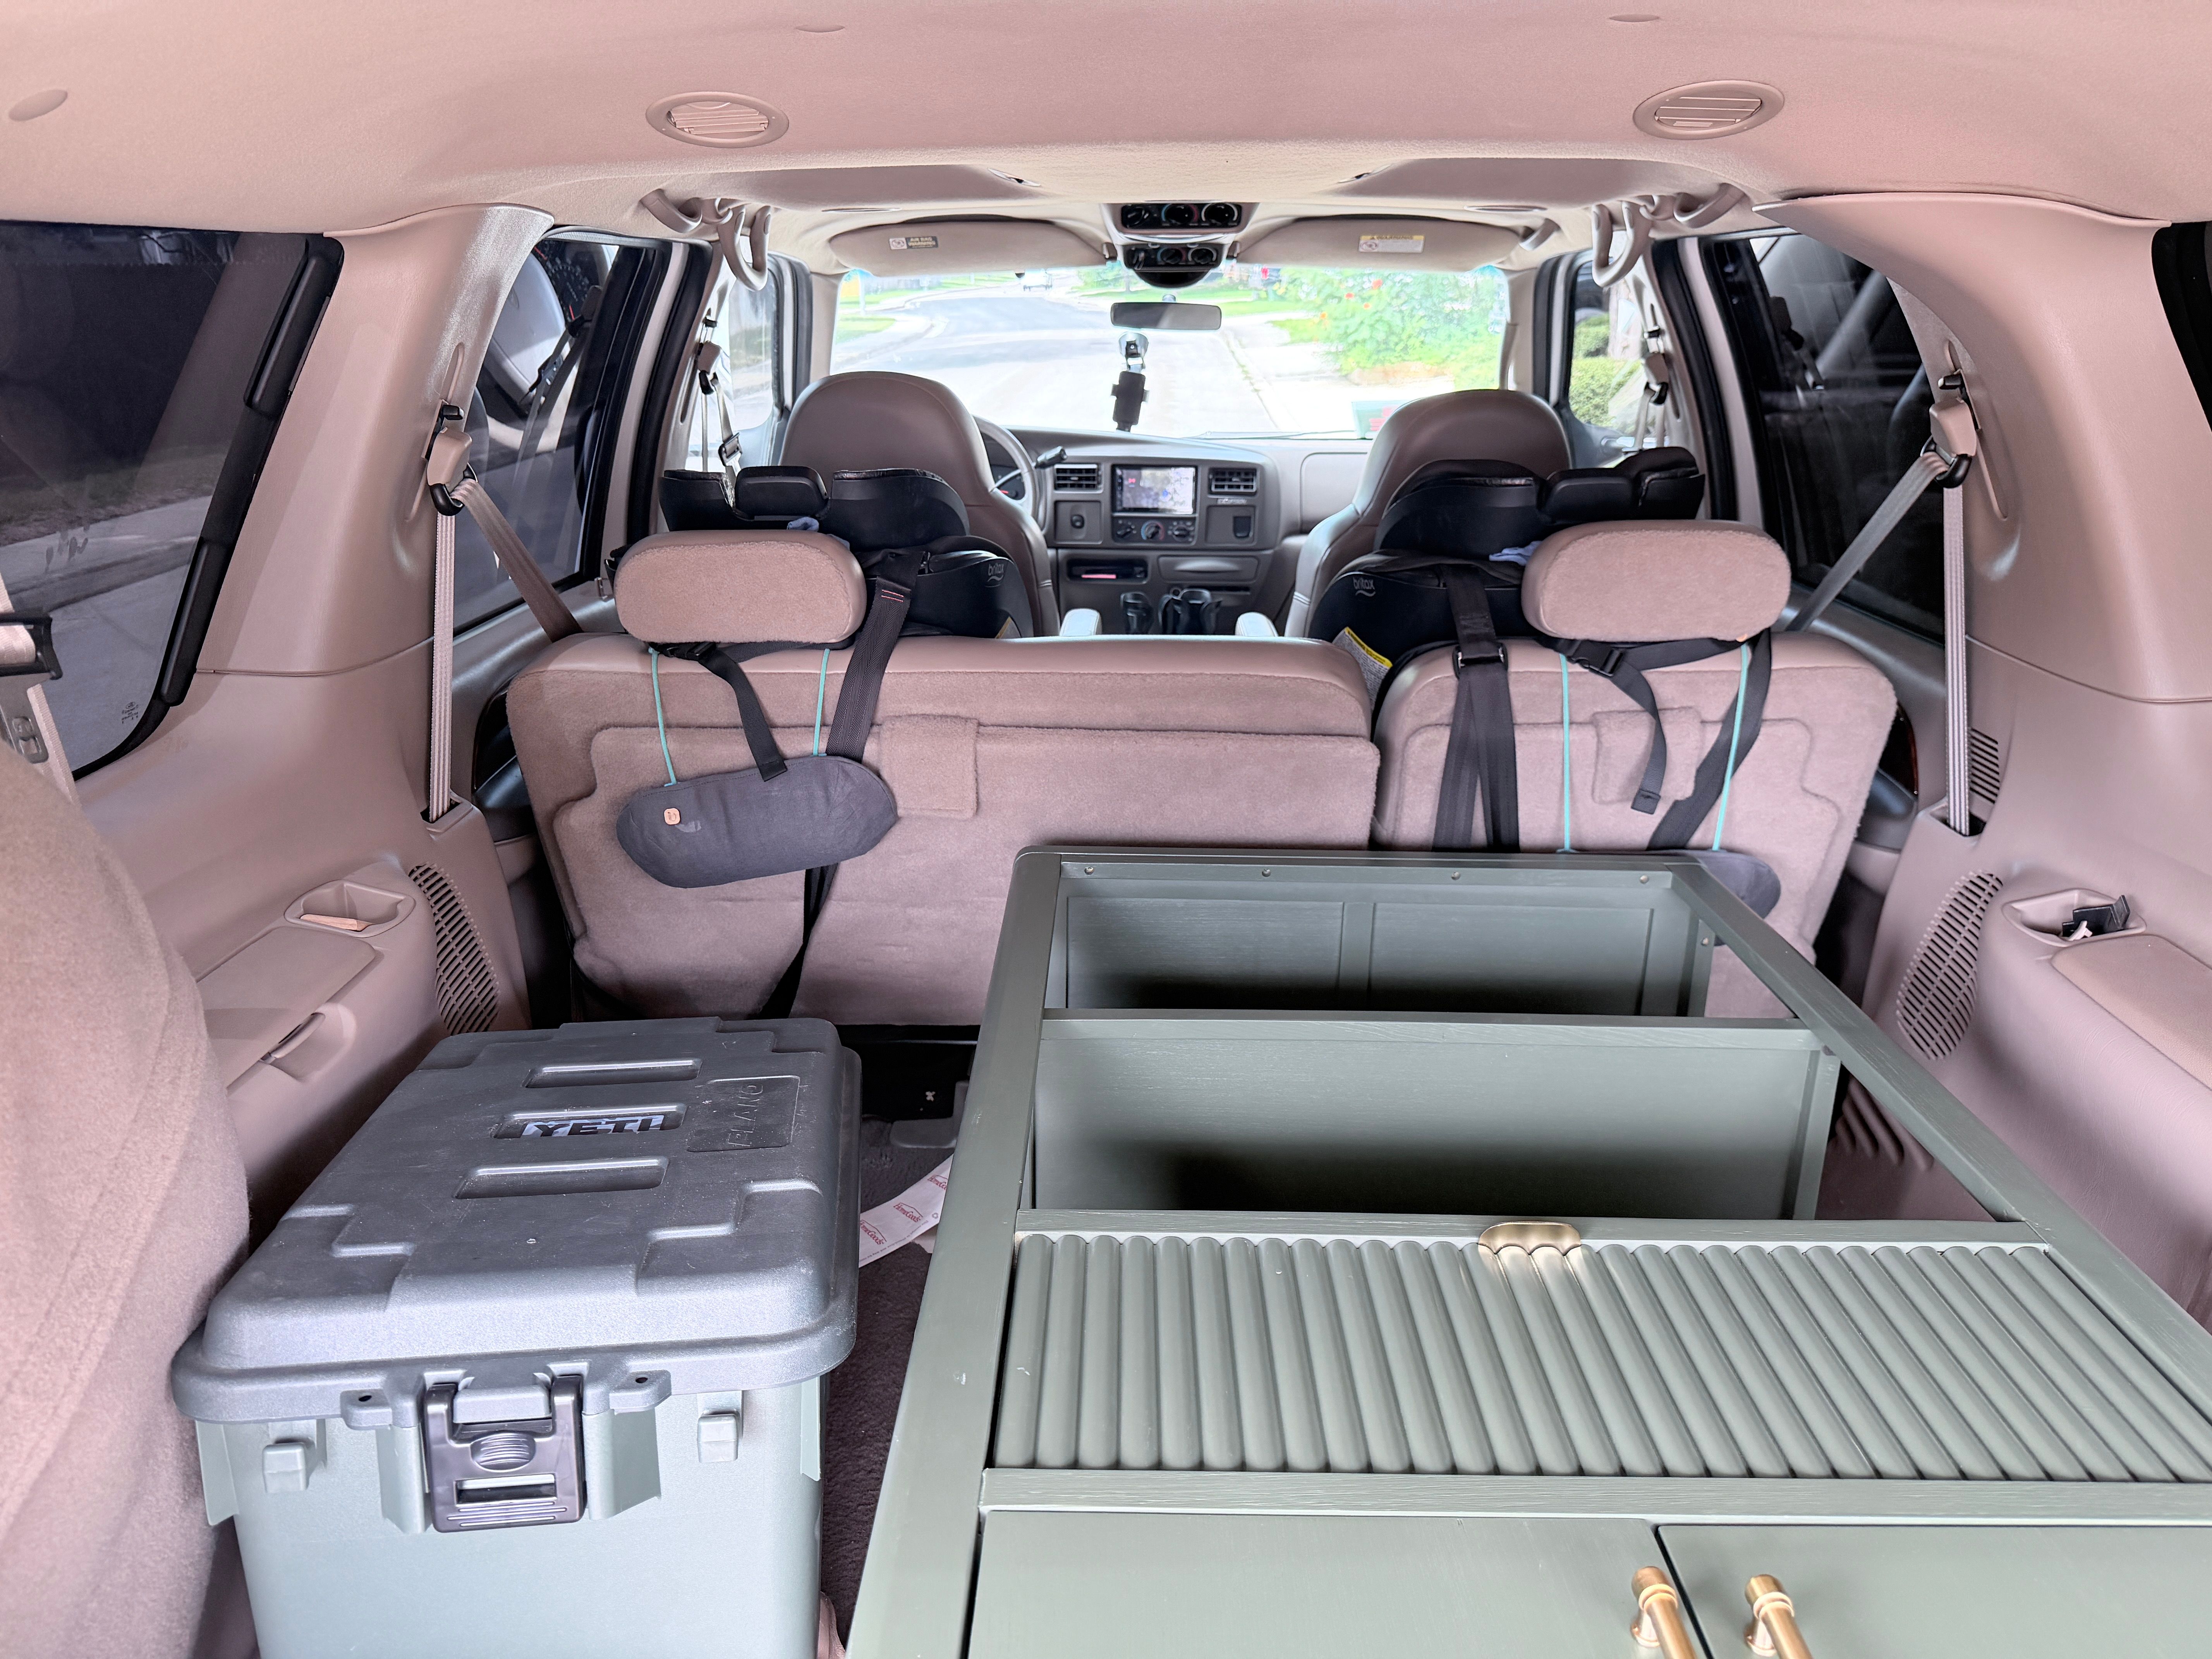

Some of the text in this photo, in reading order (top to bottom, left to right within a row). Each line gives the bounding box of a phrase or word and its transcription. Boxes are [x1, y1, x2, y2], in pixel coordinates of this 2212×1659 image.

[988, 563, 1004, 576] britax
[1353, 577, 1375, 590] britax
[533, 1118, 653, 1137] YETI
